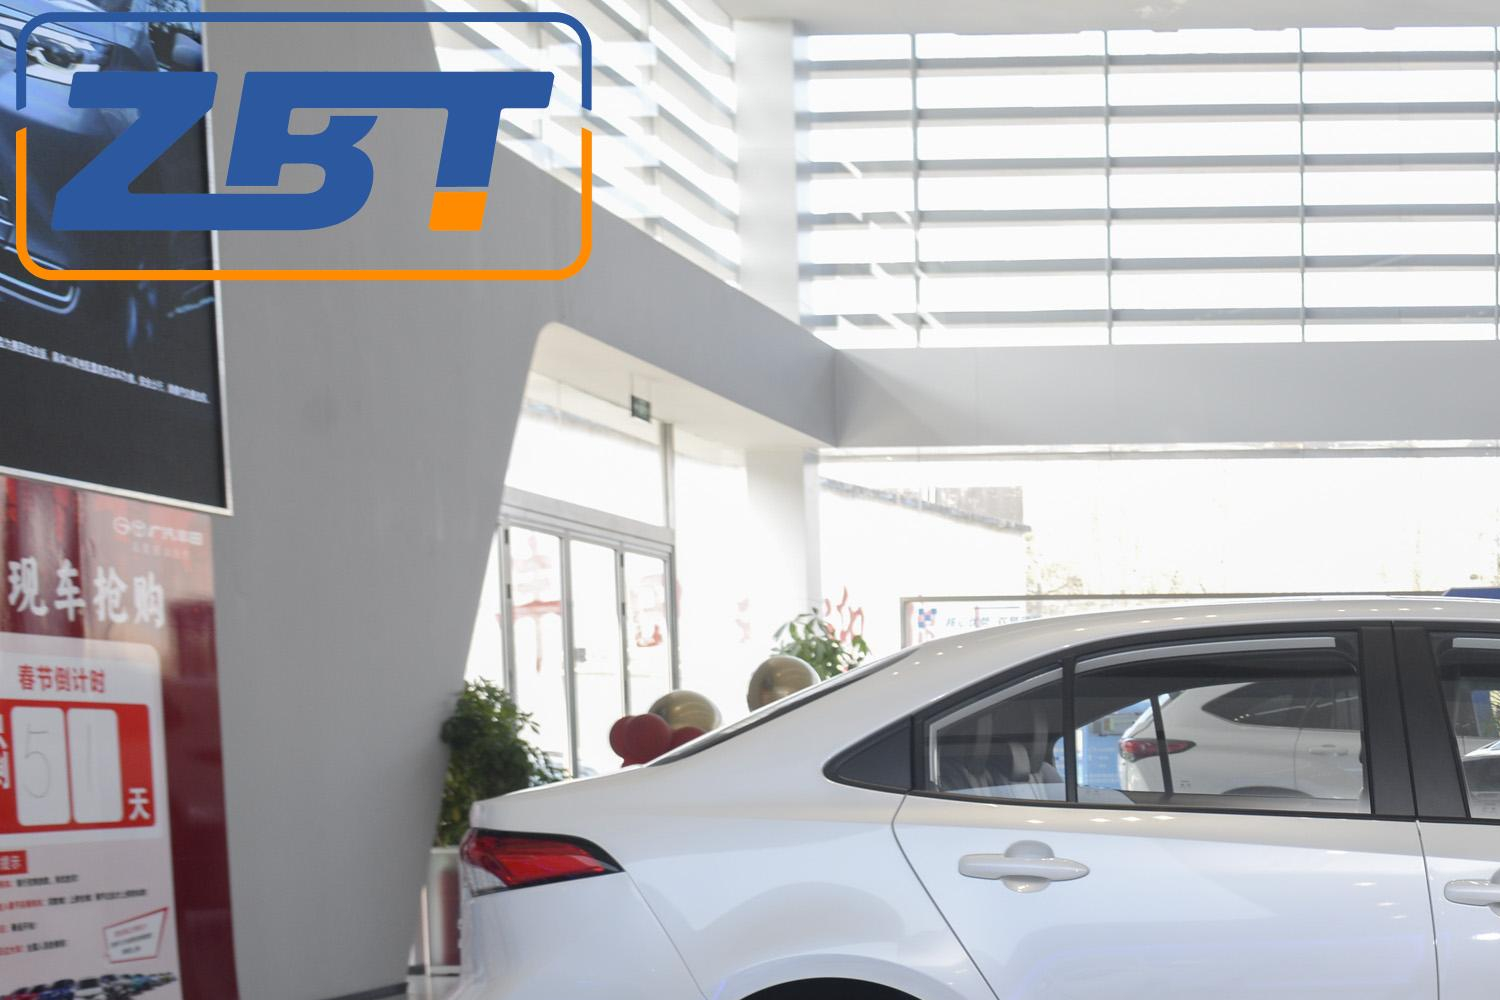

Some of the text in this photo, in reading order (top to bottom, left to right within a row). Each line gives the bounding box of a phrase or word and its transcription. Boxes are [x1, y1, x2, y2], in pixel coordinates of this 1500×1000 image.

[8, 555, 165, 629] 现车抢购
[18, 664, 105, 693] 春节倒计时
[128, 787, 151, 821] 天
